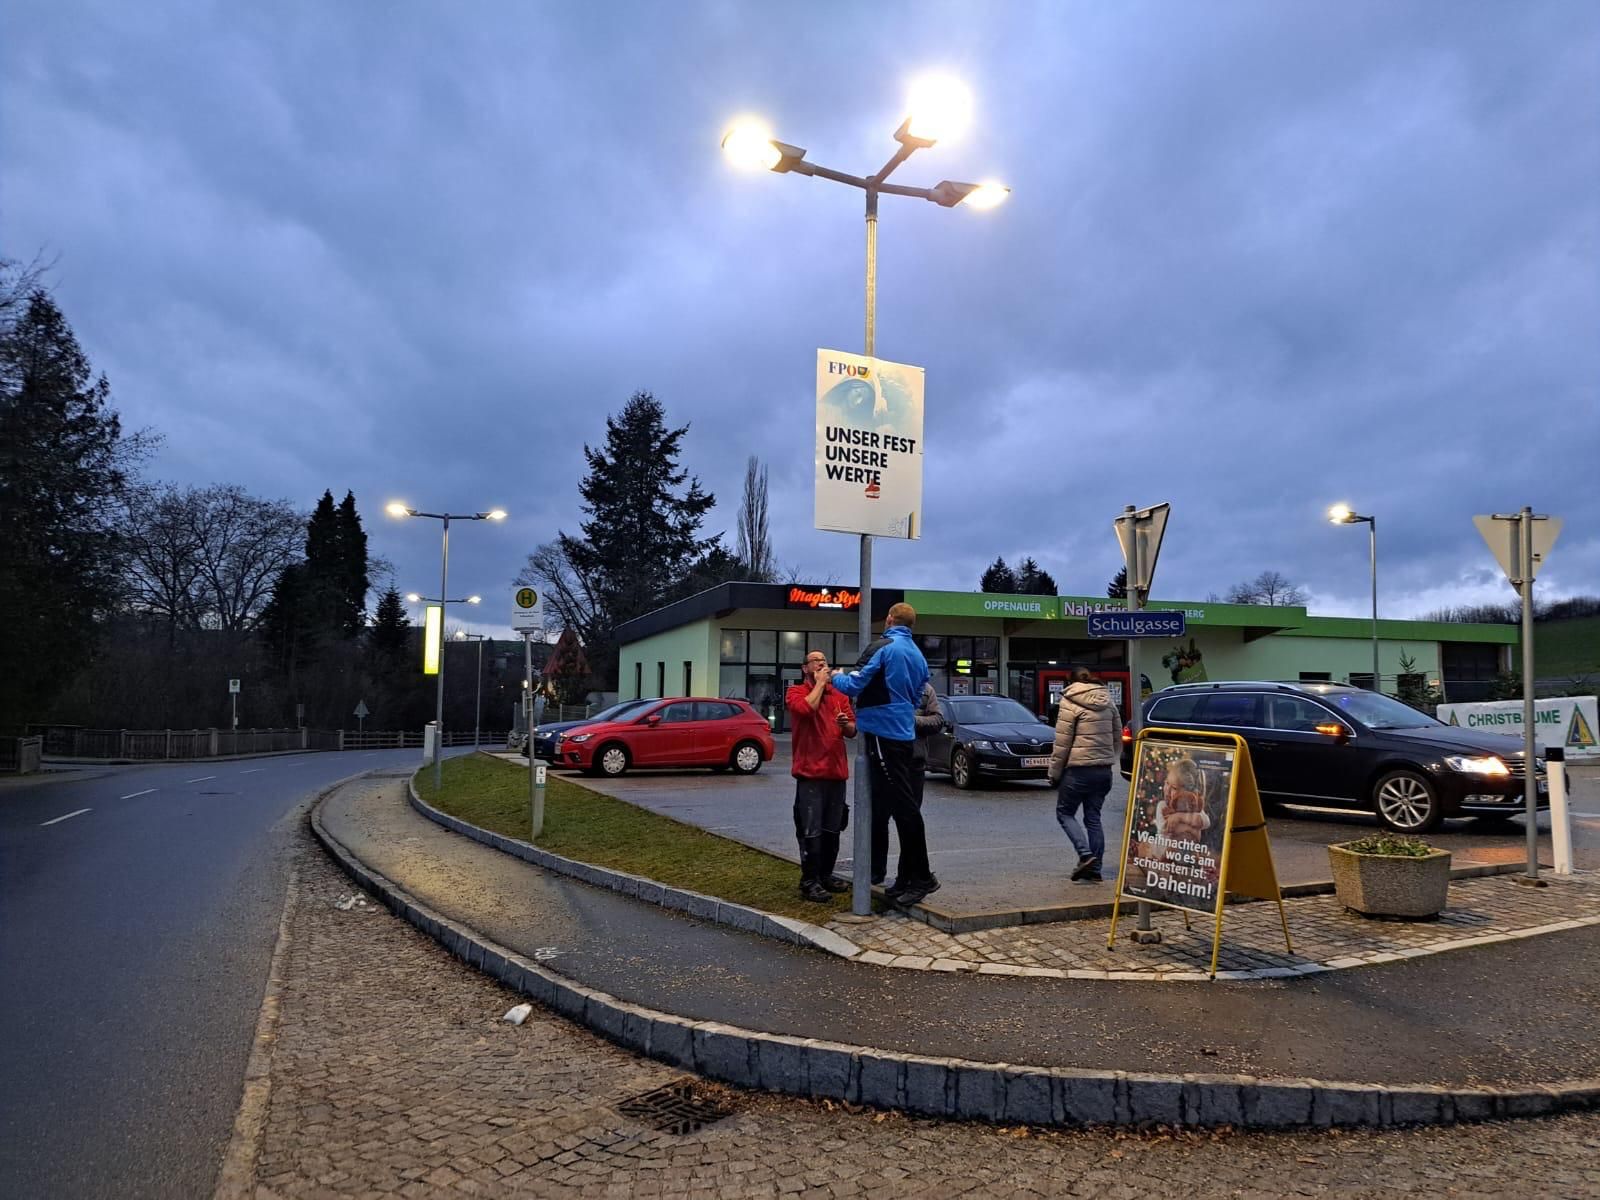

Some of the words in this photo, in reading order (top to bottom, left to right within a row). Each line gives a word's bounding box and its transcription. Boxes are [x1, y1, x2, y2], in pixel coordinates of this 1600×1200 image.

[825, 426, 880, 449] UNSER
[883, 434, 916, 454] FEST
[825, 445, 888, 468] UNSERE
[825, 463, 881, 486] WERTE
[789, 588, 832, 607] Magic
[833, 590, 863, 608] Styl
[1092, 617, 1180, 634] Schulgasse
[1468, 709, 1561, 727] CHRISTBUME
[1137, 830, 1211, 856] Weihnachten,
[1133, 856, 1188, 876] schönsten
[1190, 865, 1207, 880] ist:
[1165, 850, 1182, 861] wo
[1183, 853, 1196, 865] es
[1198, 856, 1215, 868] am
[1146, 870, 1212, 900] Daheim!
